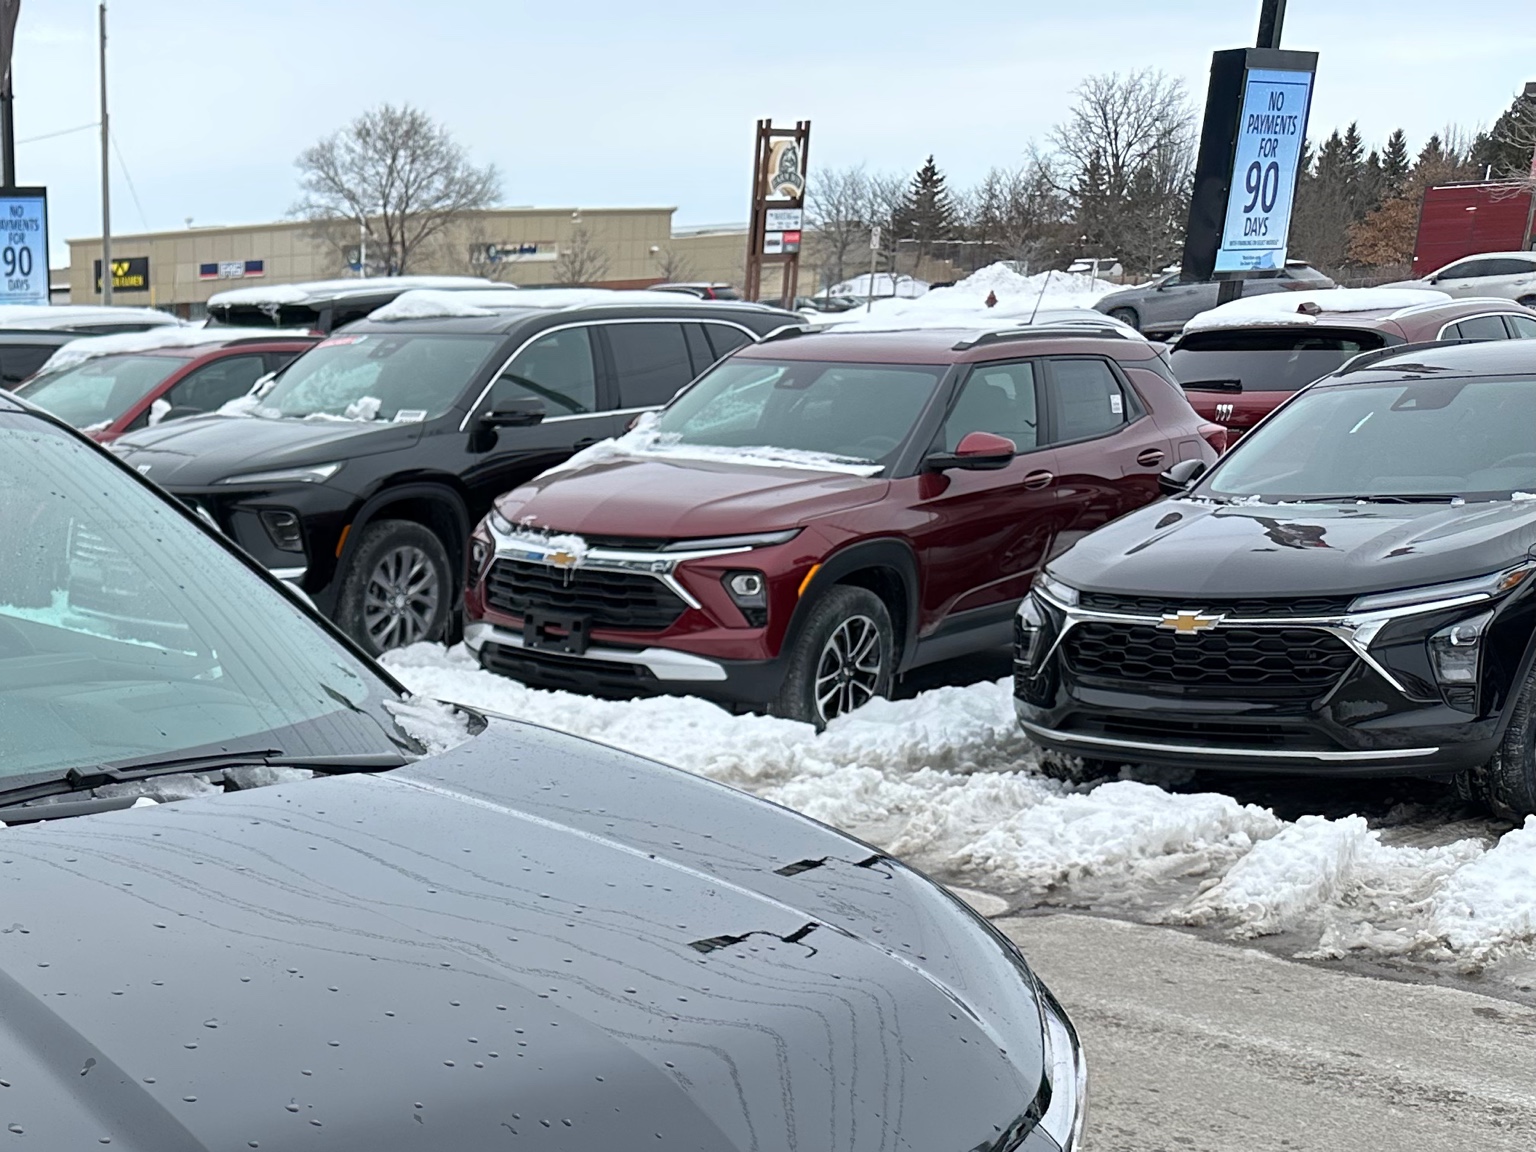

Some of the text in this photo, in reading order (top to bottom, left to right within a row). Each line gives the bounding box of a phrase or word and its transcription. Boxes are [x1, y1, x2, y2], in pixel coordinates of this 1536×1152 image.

[1267, 91, 1285, 112] NO
[1246, 114, 1298, 136] PAYMENTS
[1257, 137, 1279, 158] FOR
[1243, 160, 1280, 214] 90
[9, 205, 24, 218] NO
[1243, 216, 1269, 237] DAYS
[8, 232, 26, 245] FOR
[2, 246, 32, 277] 90
[7, 279, 30, 292] DAYS
